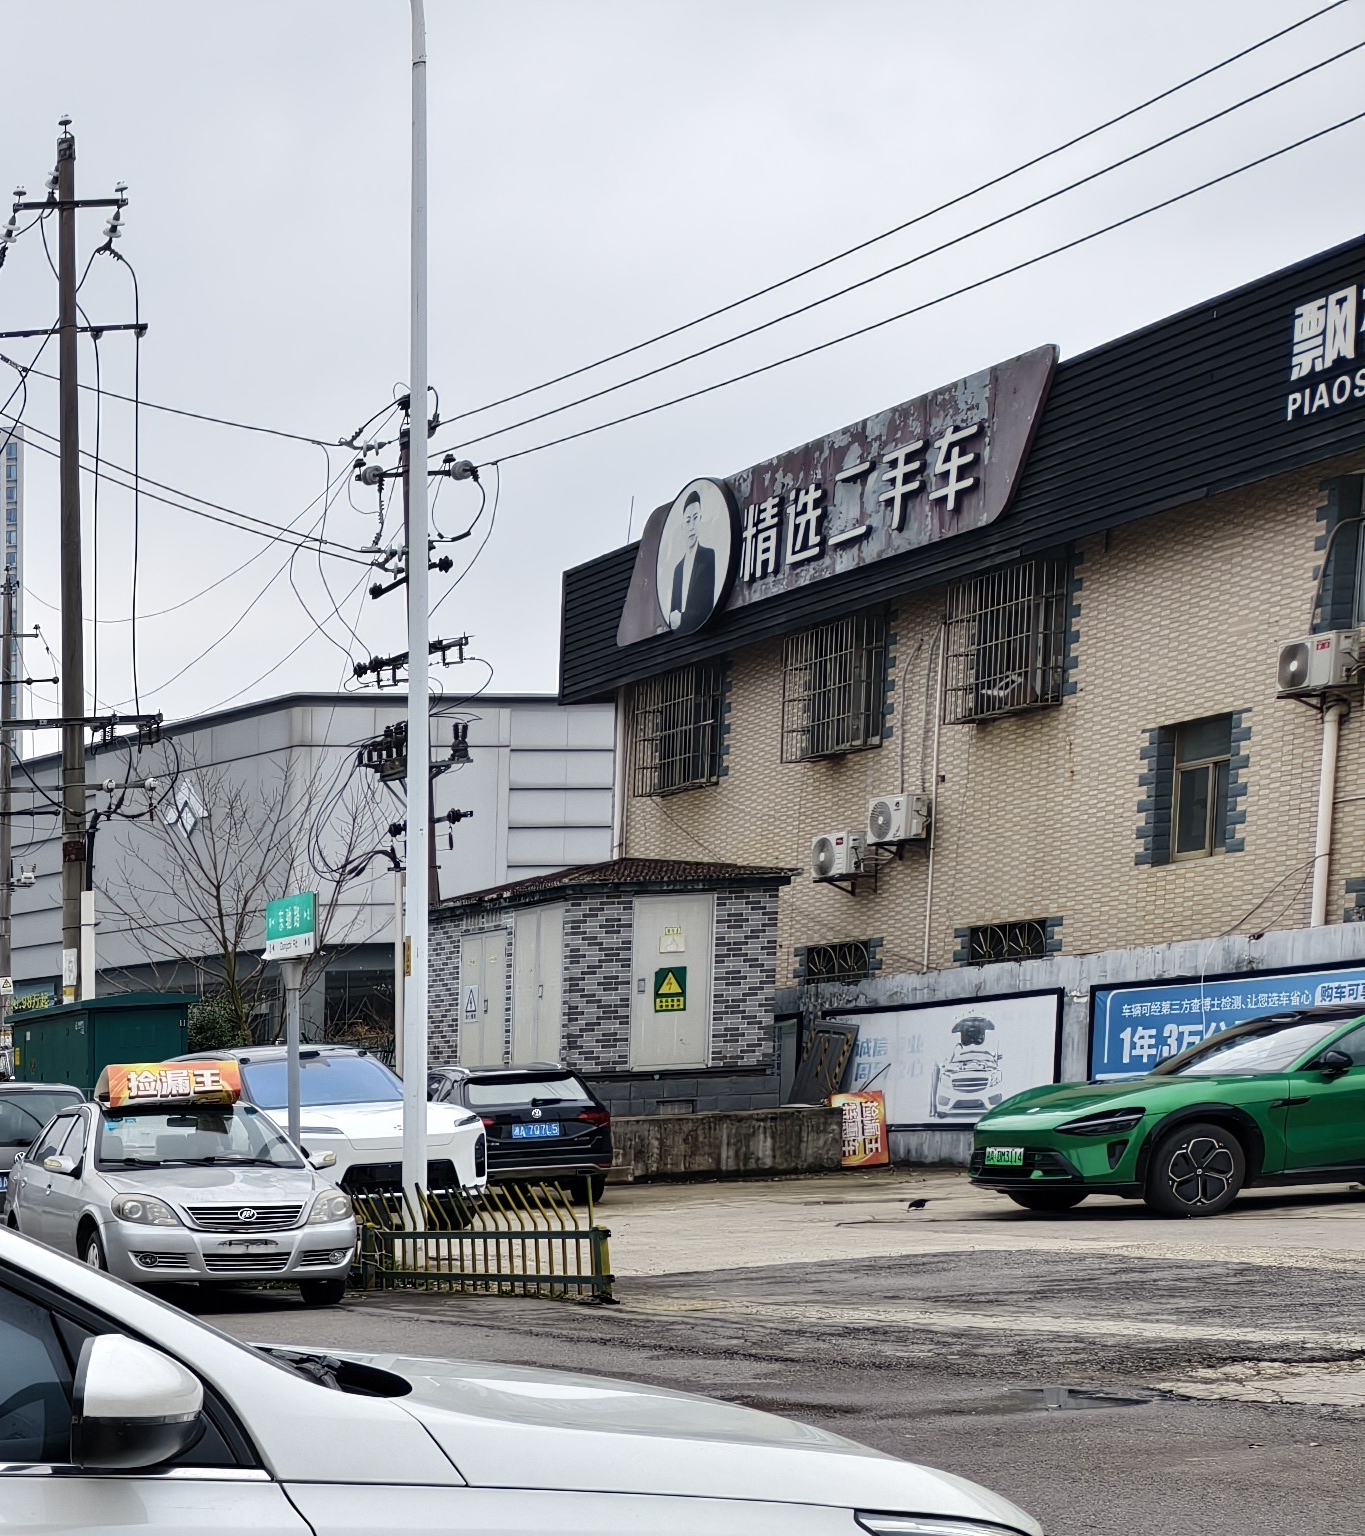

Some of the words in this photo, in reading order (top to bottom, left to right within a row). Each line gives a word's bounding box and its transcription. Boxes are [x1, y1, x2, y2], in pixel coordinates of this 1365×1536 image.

[1290, 284, 1365, 381] 飘
[740, 424, 979, 583] 精选二手车
[1119, 1020, 1245, 1064] 1年/3万
[128, 1069, 224, 1099] 捡漏王
[860, 1101, 882, 1155] 捡漏王
